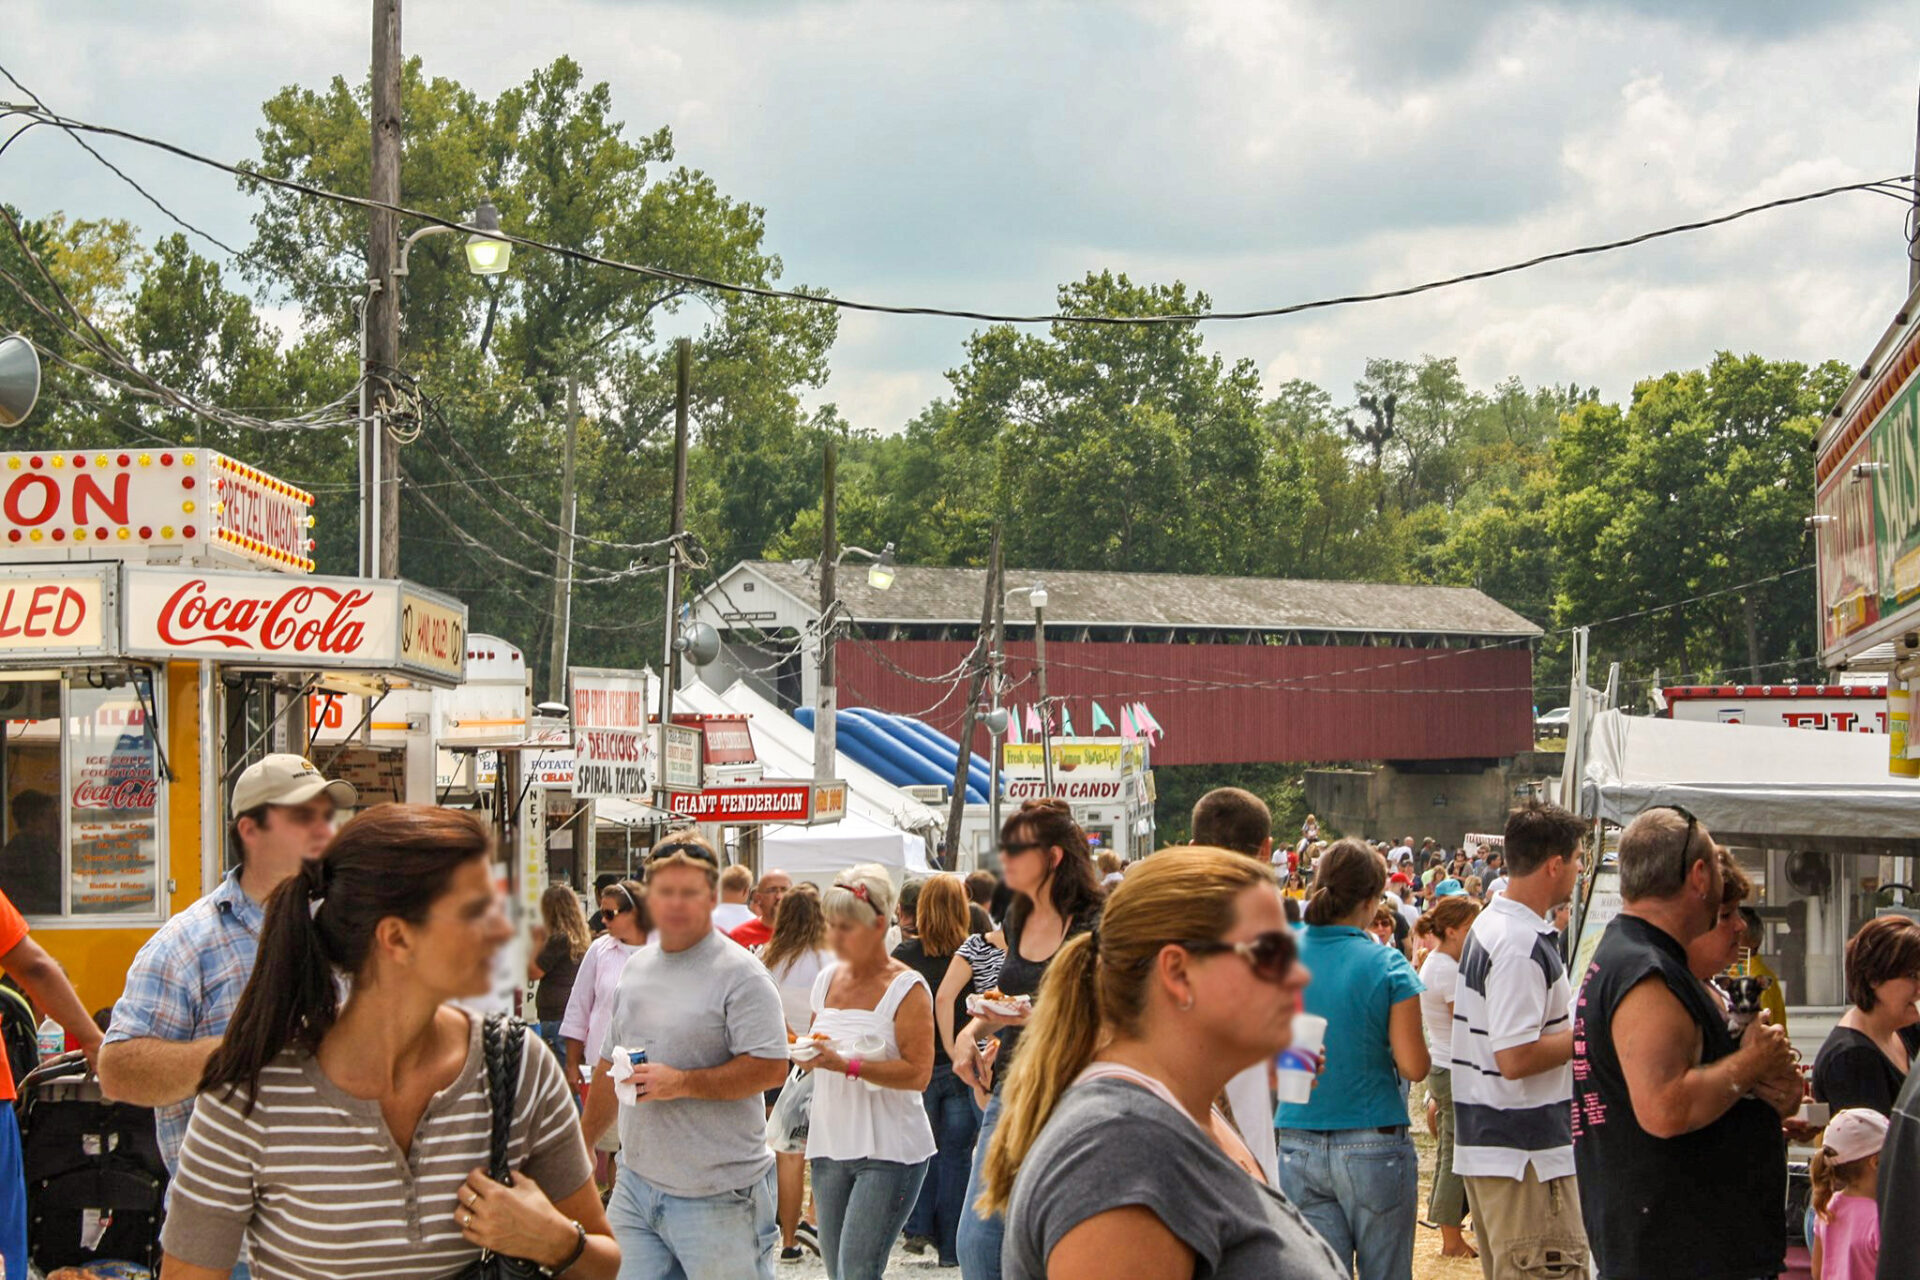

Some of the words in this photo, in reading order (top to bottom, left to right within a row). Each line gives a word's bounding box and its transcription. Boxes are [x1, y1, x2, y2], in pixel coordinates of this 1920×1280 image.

[220, 477, 265, 543] PRETZEL
[266, 495, 300, 558] WAGON
[156, 579, 374, 654] Coca-Cola
[588, 732, 639, 763] DELICIOUS
[72, 778, 159, 809] Coca-Cola
[577, 765, 613, 794] SPIRAL
[615, 766, 648, 795] TATERS
[1070, 782, 1120, 798] CANDY
[674, 794, 717, 813] GIANT
[720, 792, 804, 812] TENDERLOIN
